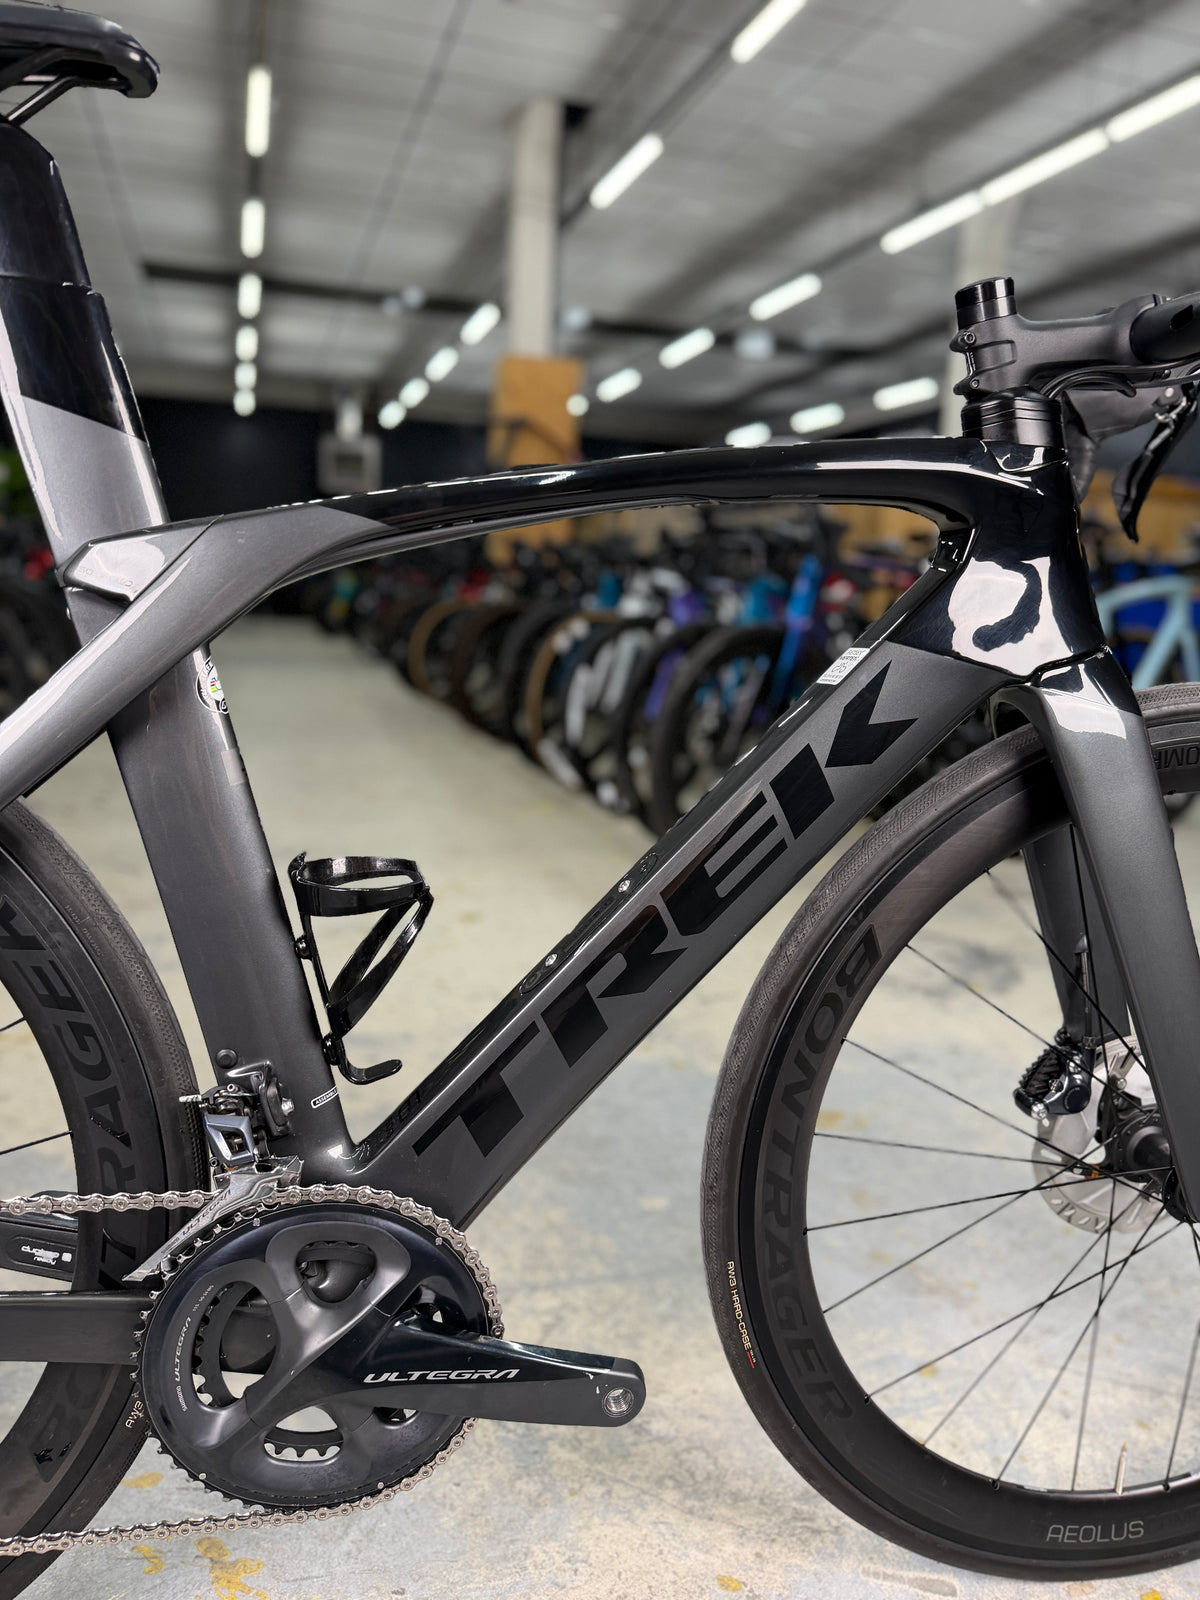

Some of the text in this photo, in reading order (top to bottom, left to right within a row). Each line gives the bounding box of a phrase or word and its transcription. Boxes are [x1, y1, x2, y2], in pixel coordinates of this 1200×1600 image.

[411, 658, 919, 1158] TREK
[761, 922, 885, 1429] BONTRAGER
[727, 1260, 752, 1351] AW3 HARD-CASE
[174, 1316, 192, 1382] ULTEGRA
[363, 1368, 520, 1384] ULTEGRA
[125, 1400, 144, 1429] AW3
[1046, 1520, 1145, 1544] AEOLUS
